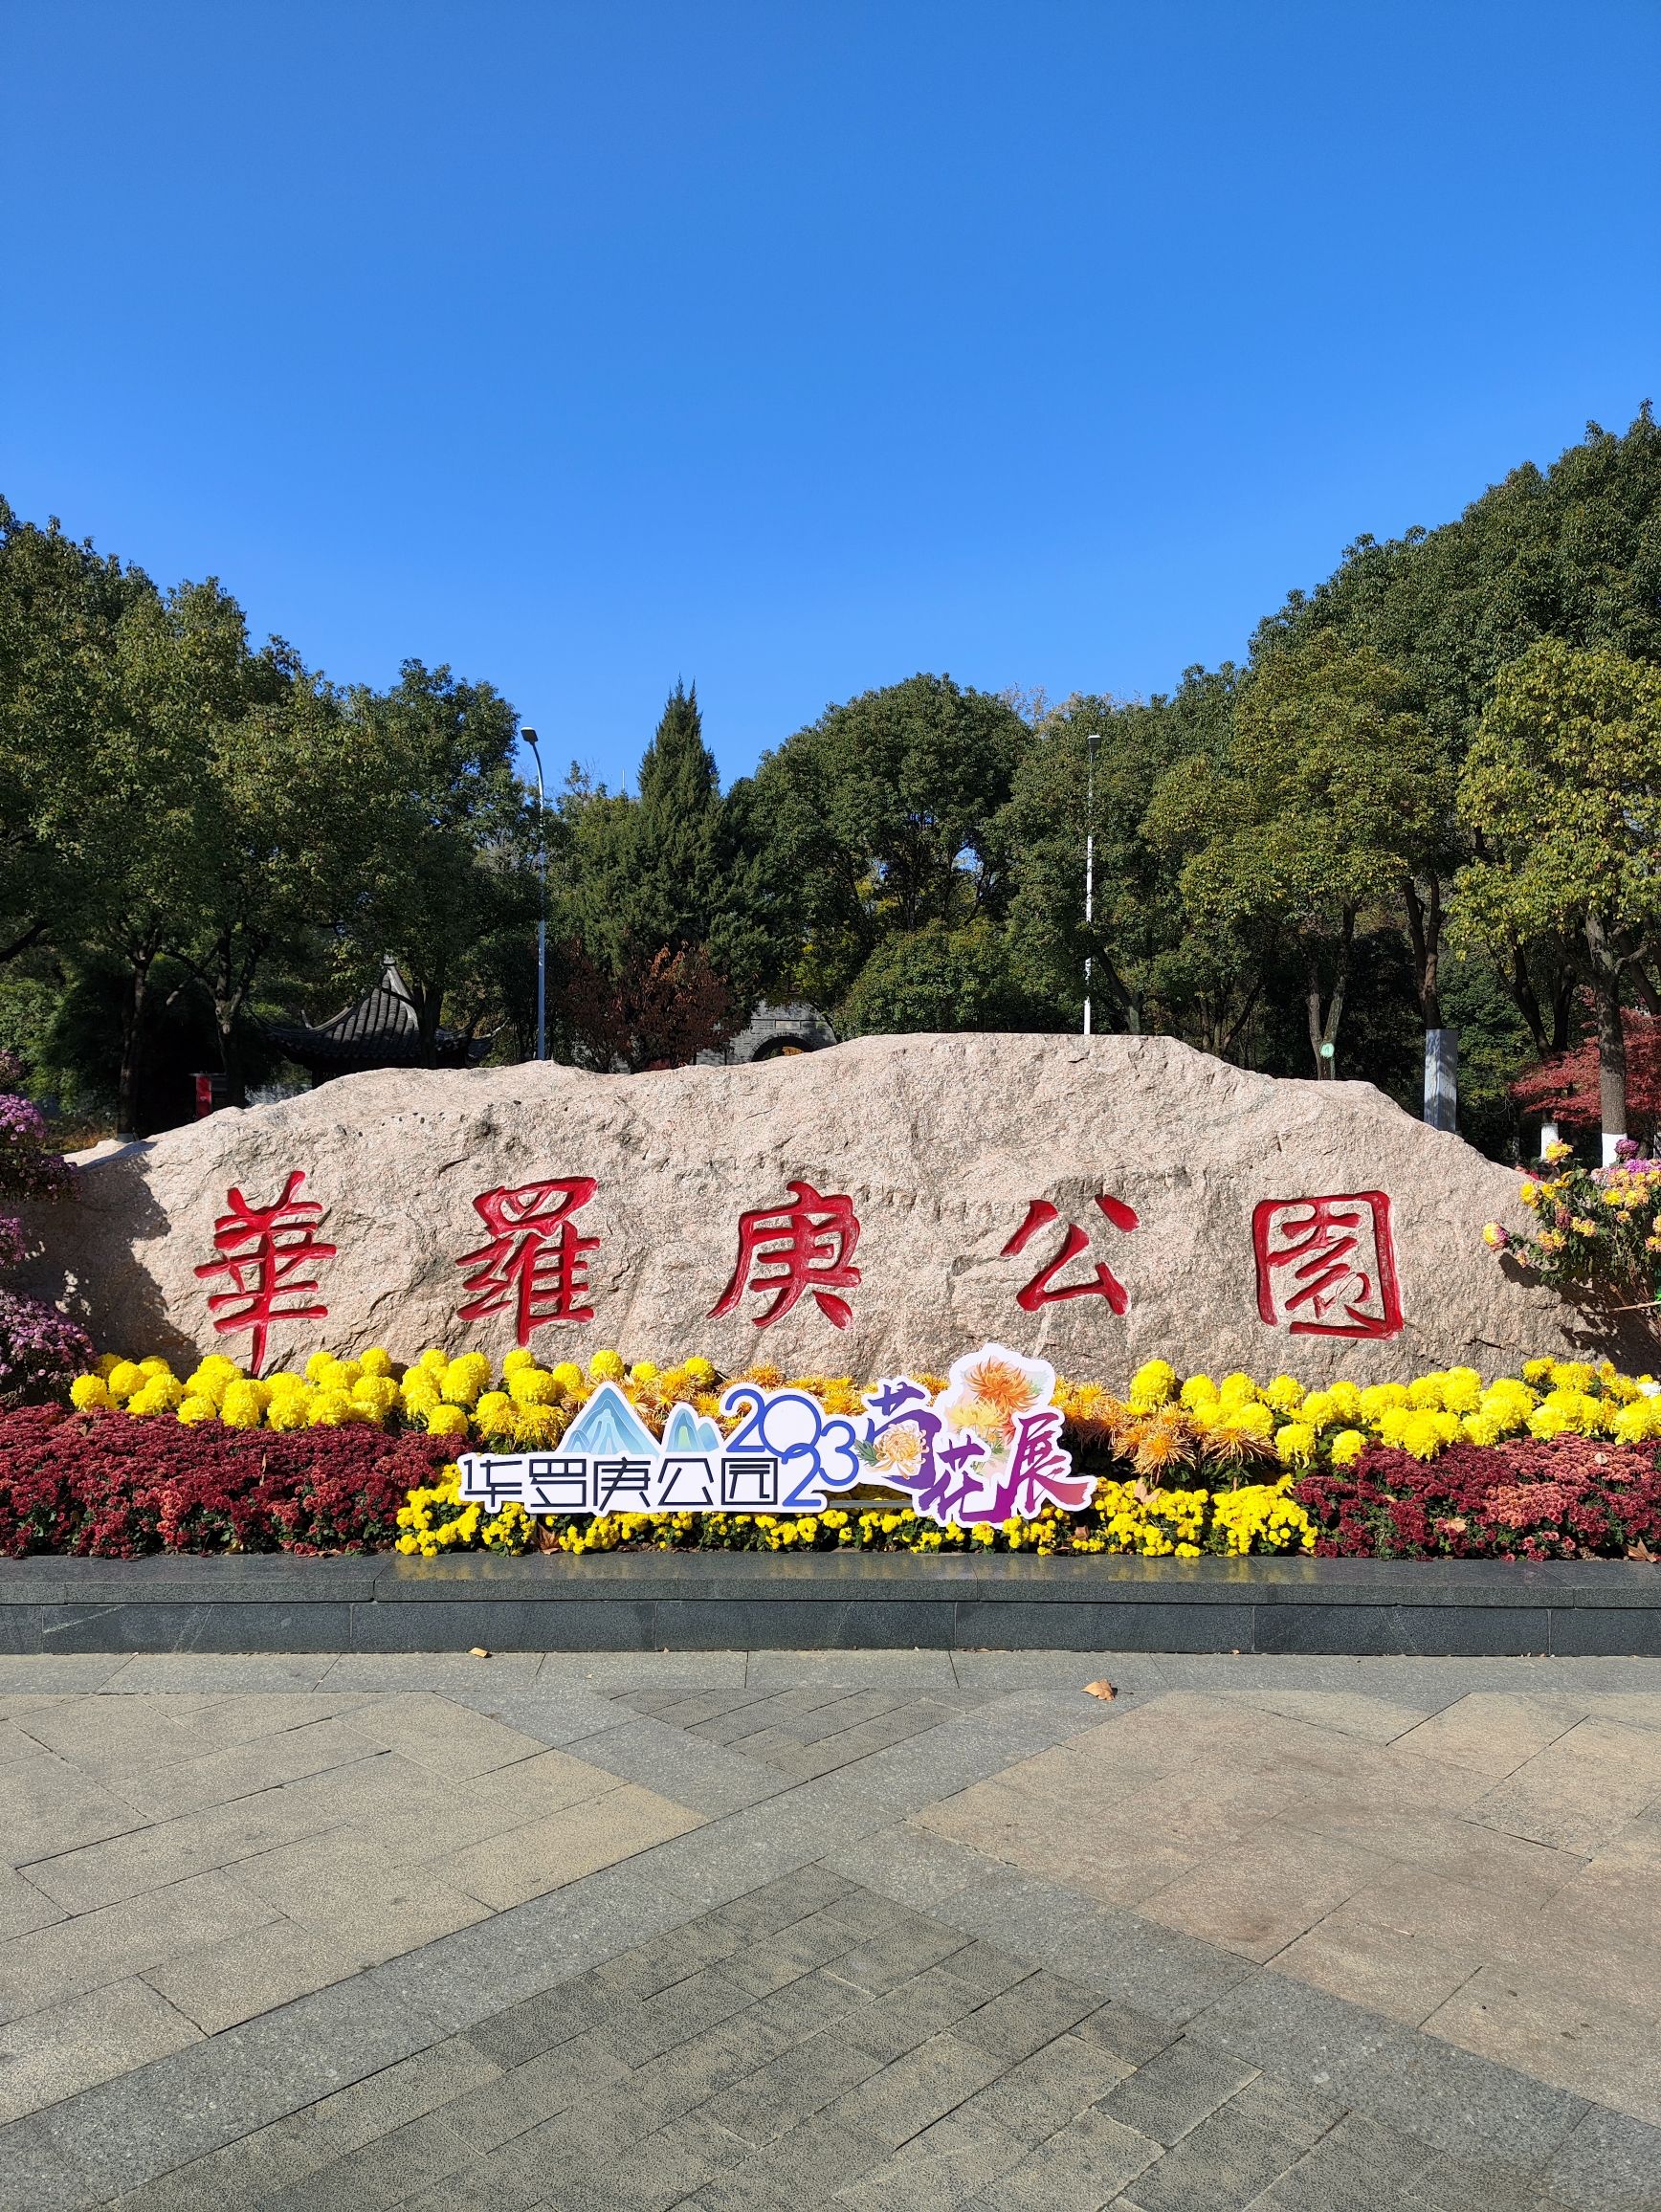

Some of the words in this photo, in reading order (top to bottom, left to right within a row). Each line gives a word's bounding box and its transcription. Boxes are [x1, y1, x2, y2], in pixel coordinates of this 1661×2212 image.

[193, 1170, 1405, 1376] 華羅庚公園
[463, 1456, 778, 1512] 华罗庚公园
[724, 1387, 860, 1508] 2023
